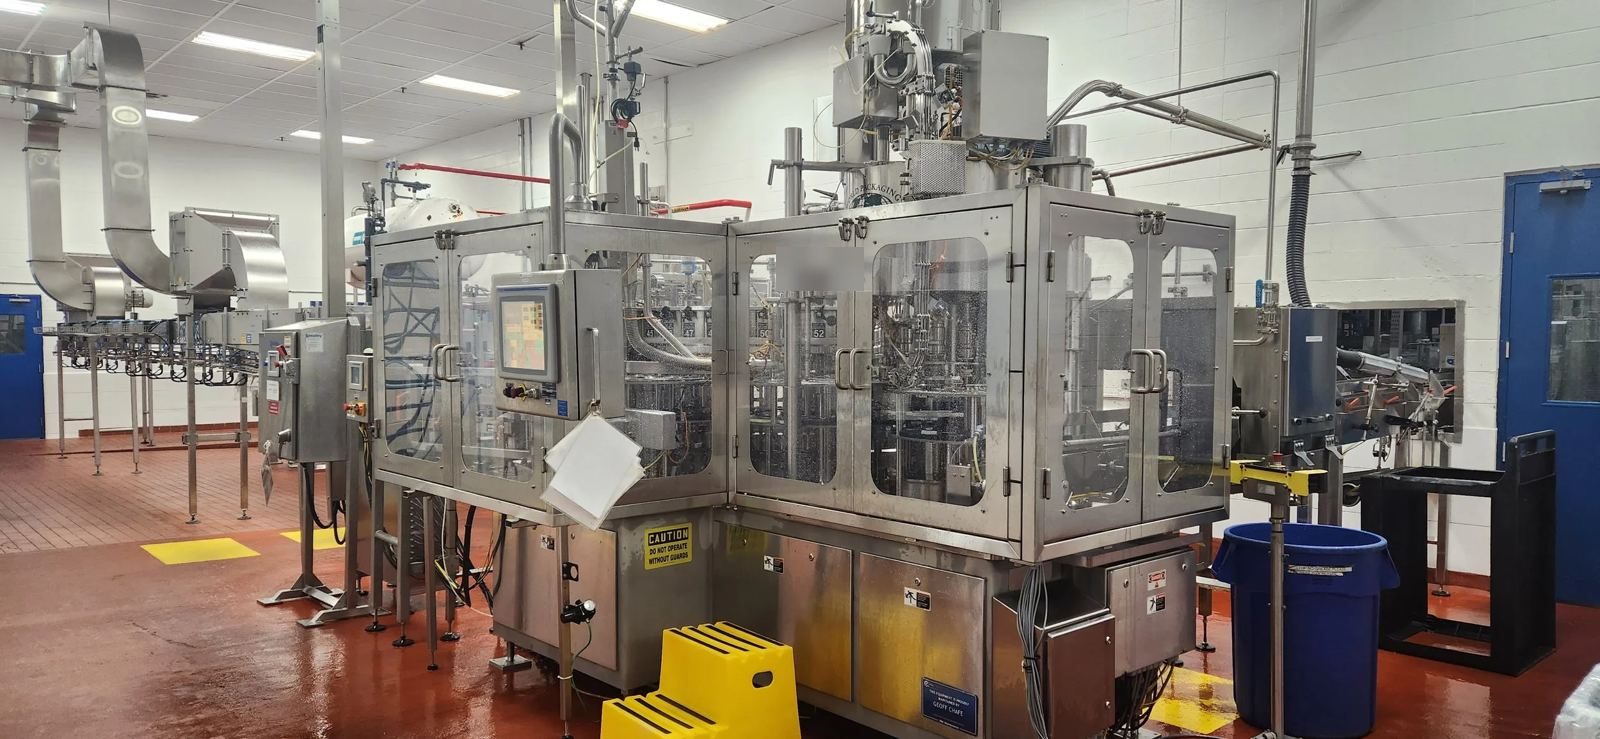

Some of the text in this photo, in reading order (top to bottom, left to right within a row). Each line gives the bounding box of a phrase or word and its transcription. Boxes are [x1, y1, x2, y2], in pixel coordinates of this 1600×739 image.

[684, 329, 693, 337] 47
[814, 329, 825, 338] 52
[649, 529, 688, 544] CAUTION
[668, 542, 687, 552] OPERATE
[649, 552, 688, 564] WITHOUT GUARDS
